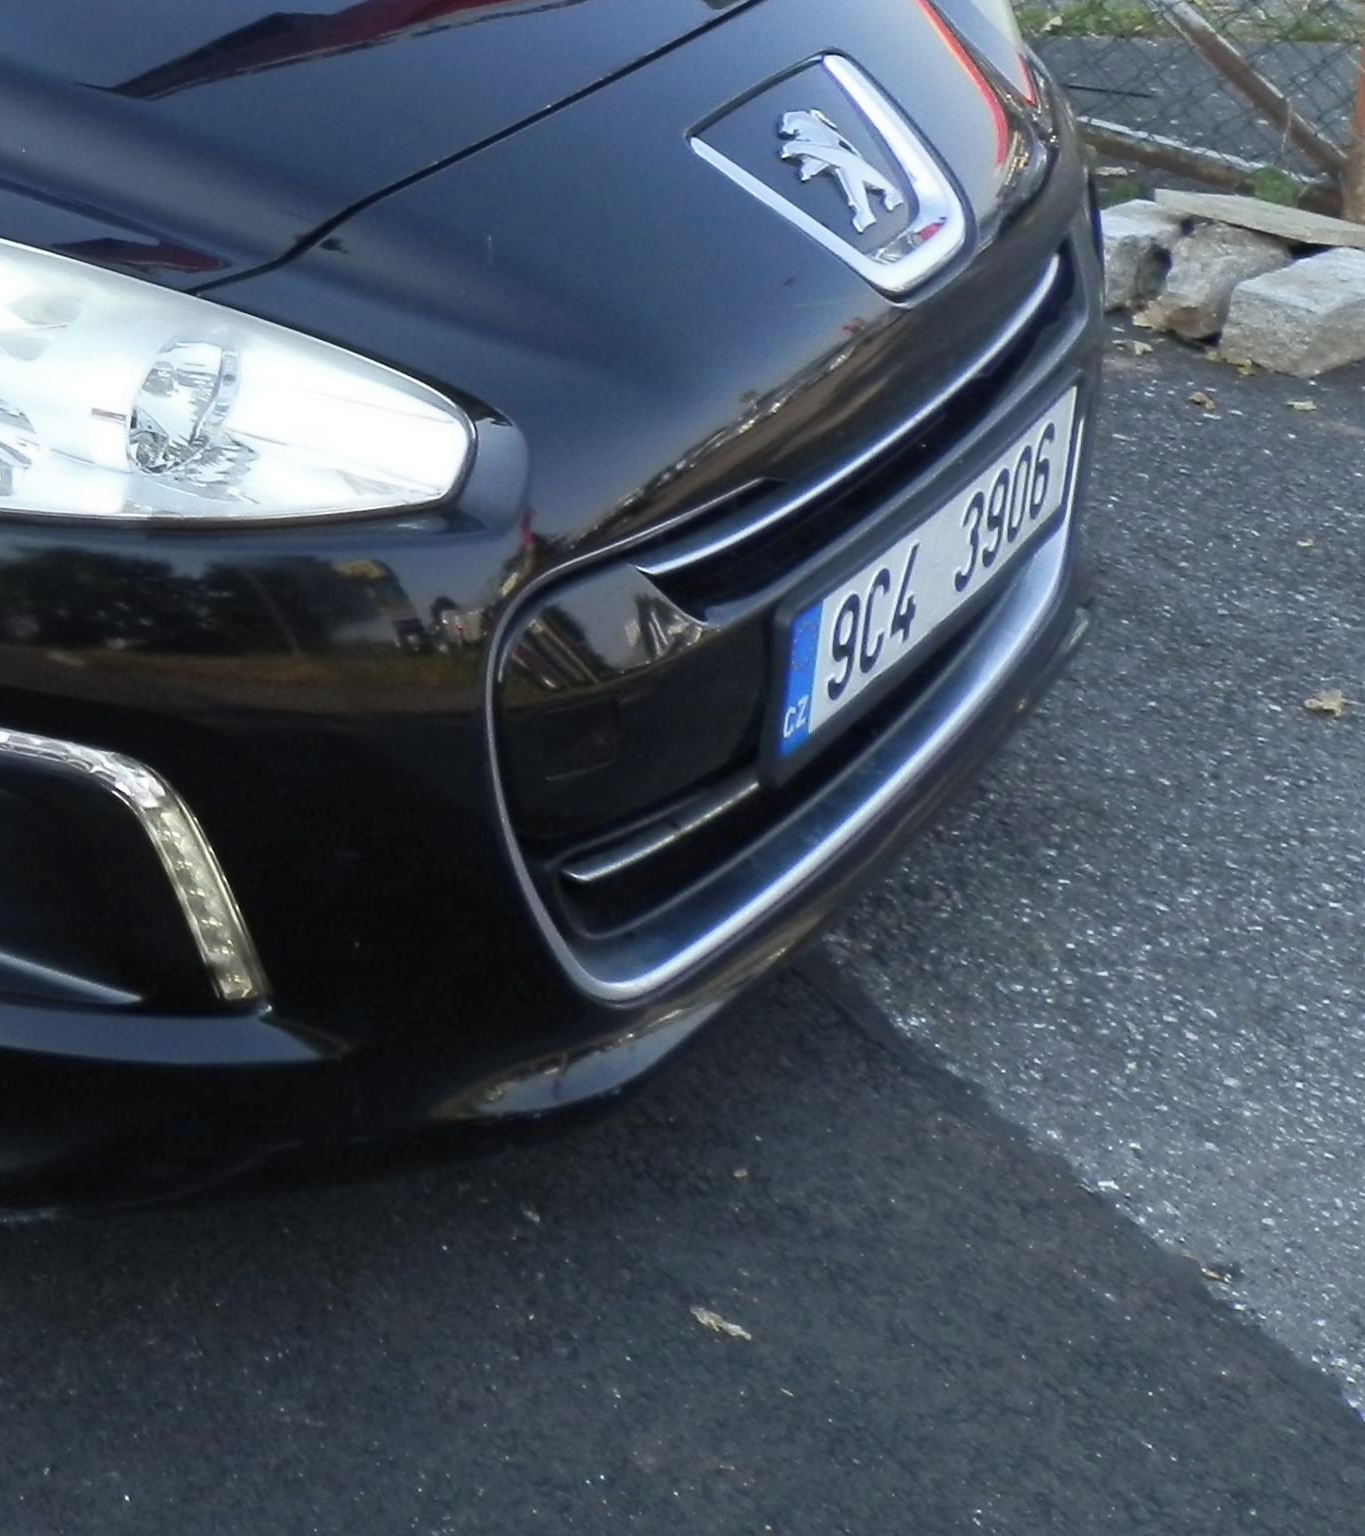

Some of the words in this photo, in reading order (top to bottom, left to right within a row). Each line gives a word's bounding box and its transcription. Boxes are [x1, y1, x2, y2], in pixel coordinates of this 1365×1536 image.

[826, 542, 921, 702] 9C4
[953, 422, 1056, 593] 3906
[783, 694, 810, 739] CZ
